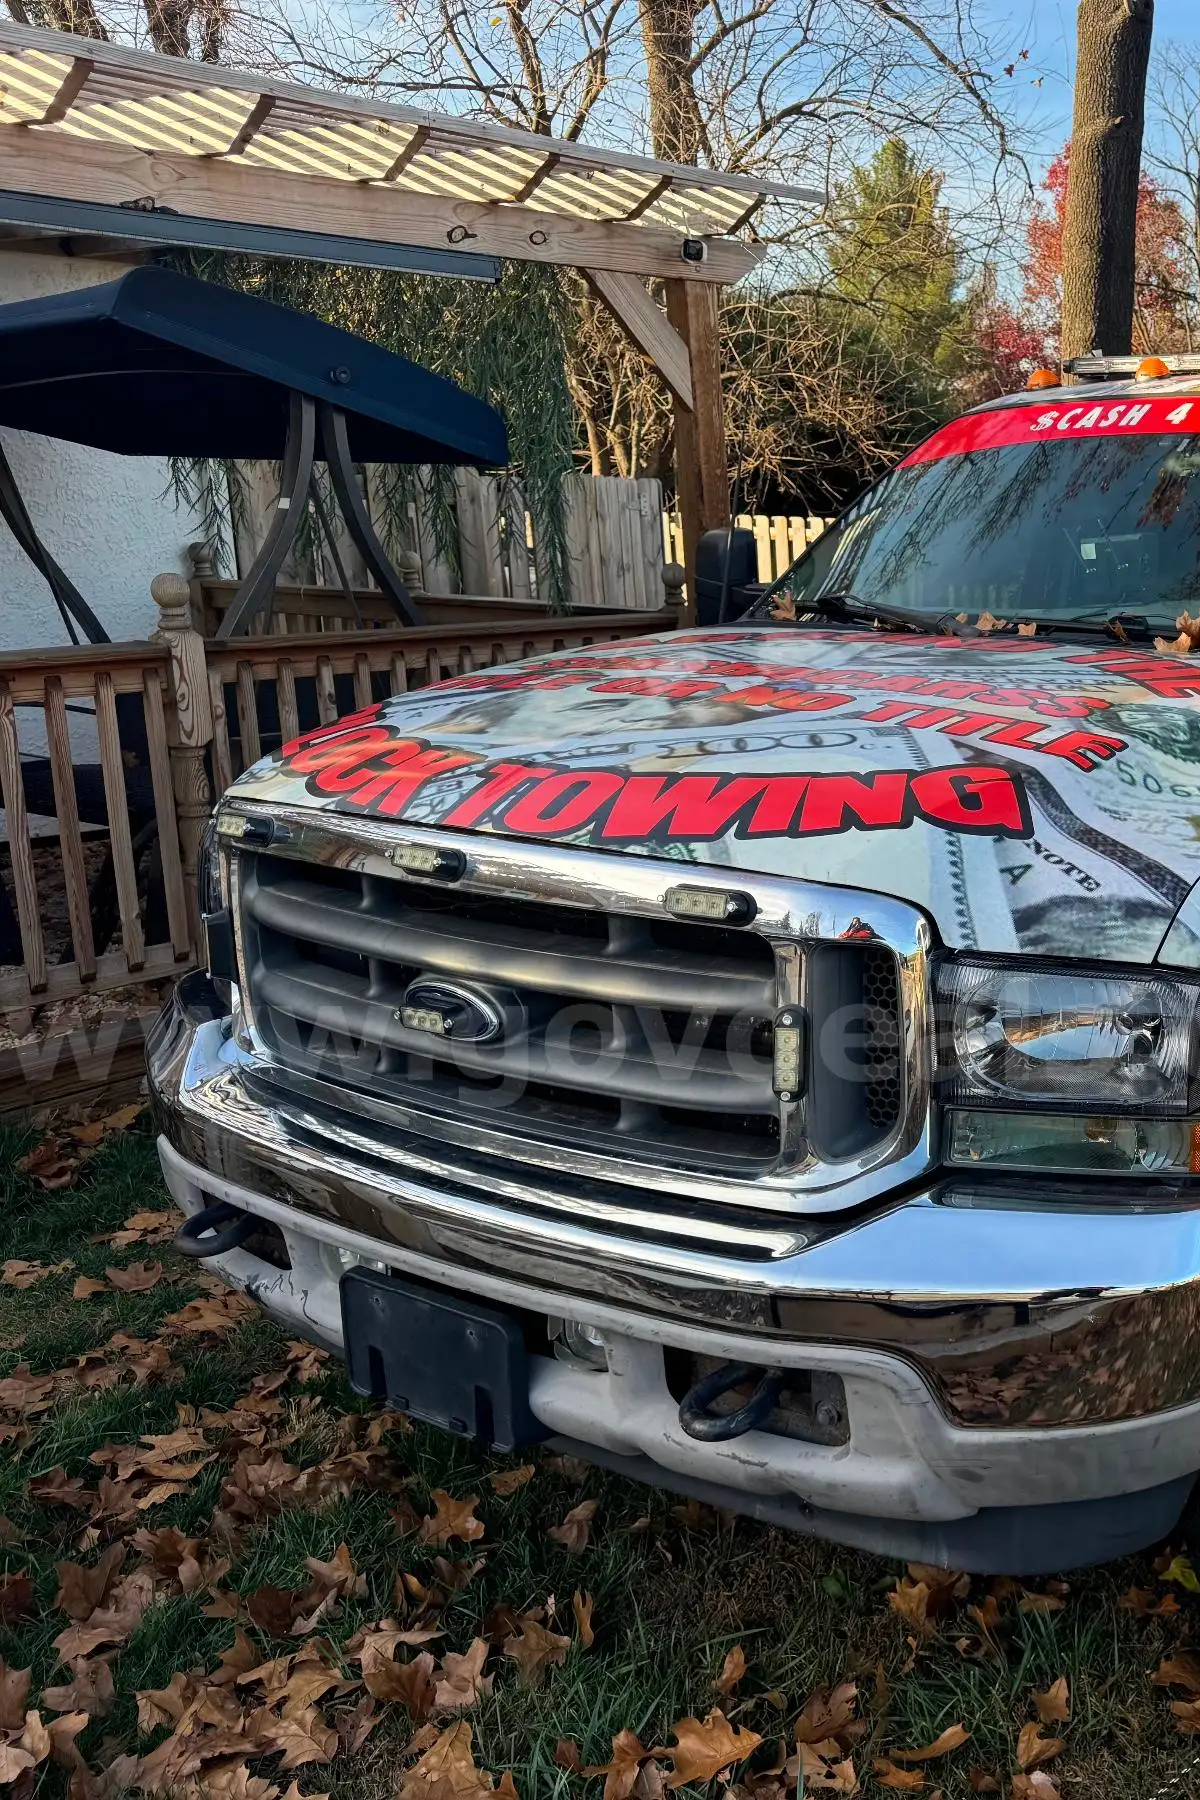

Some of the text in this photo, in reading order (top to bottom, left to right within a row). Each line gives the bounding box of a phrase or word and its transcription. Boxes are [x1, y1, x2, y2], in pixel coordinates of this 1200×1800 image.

[1029, 403, 1152, 431] $CASH
[1164, 402, 1194, 425] 4
[587, 676, 729, 699] OR
[712, 683, 857, 712] NO
[857, 700, 1130, 773] TITLE
[430, 757, 1034, 842] TOWING
[1022, 839, 1101, 893] NOTE
